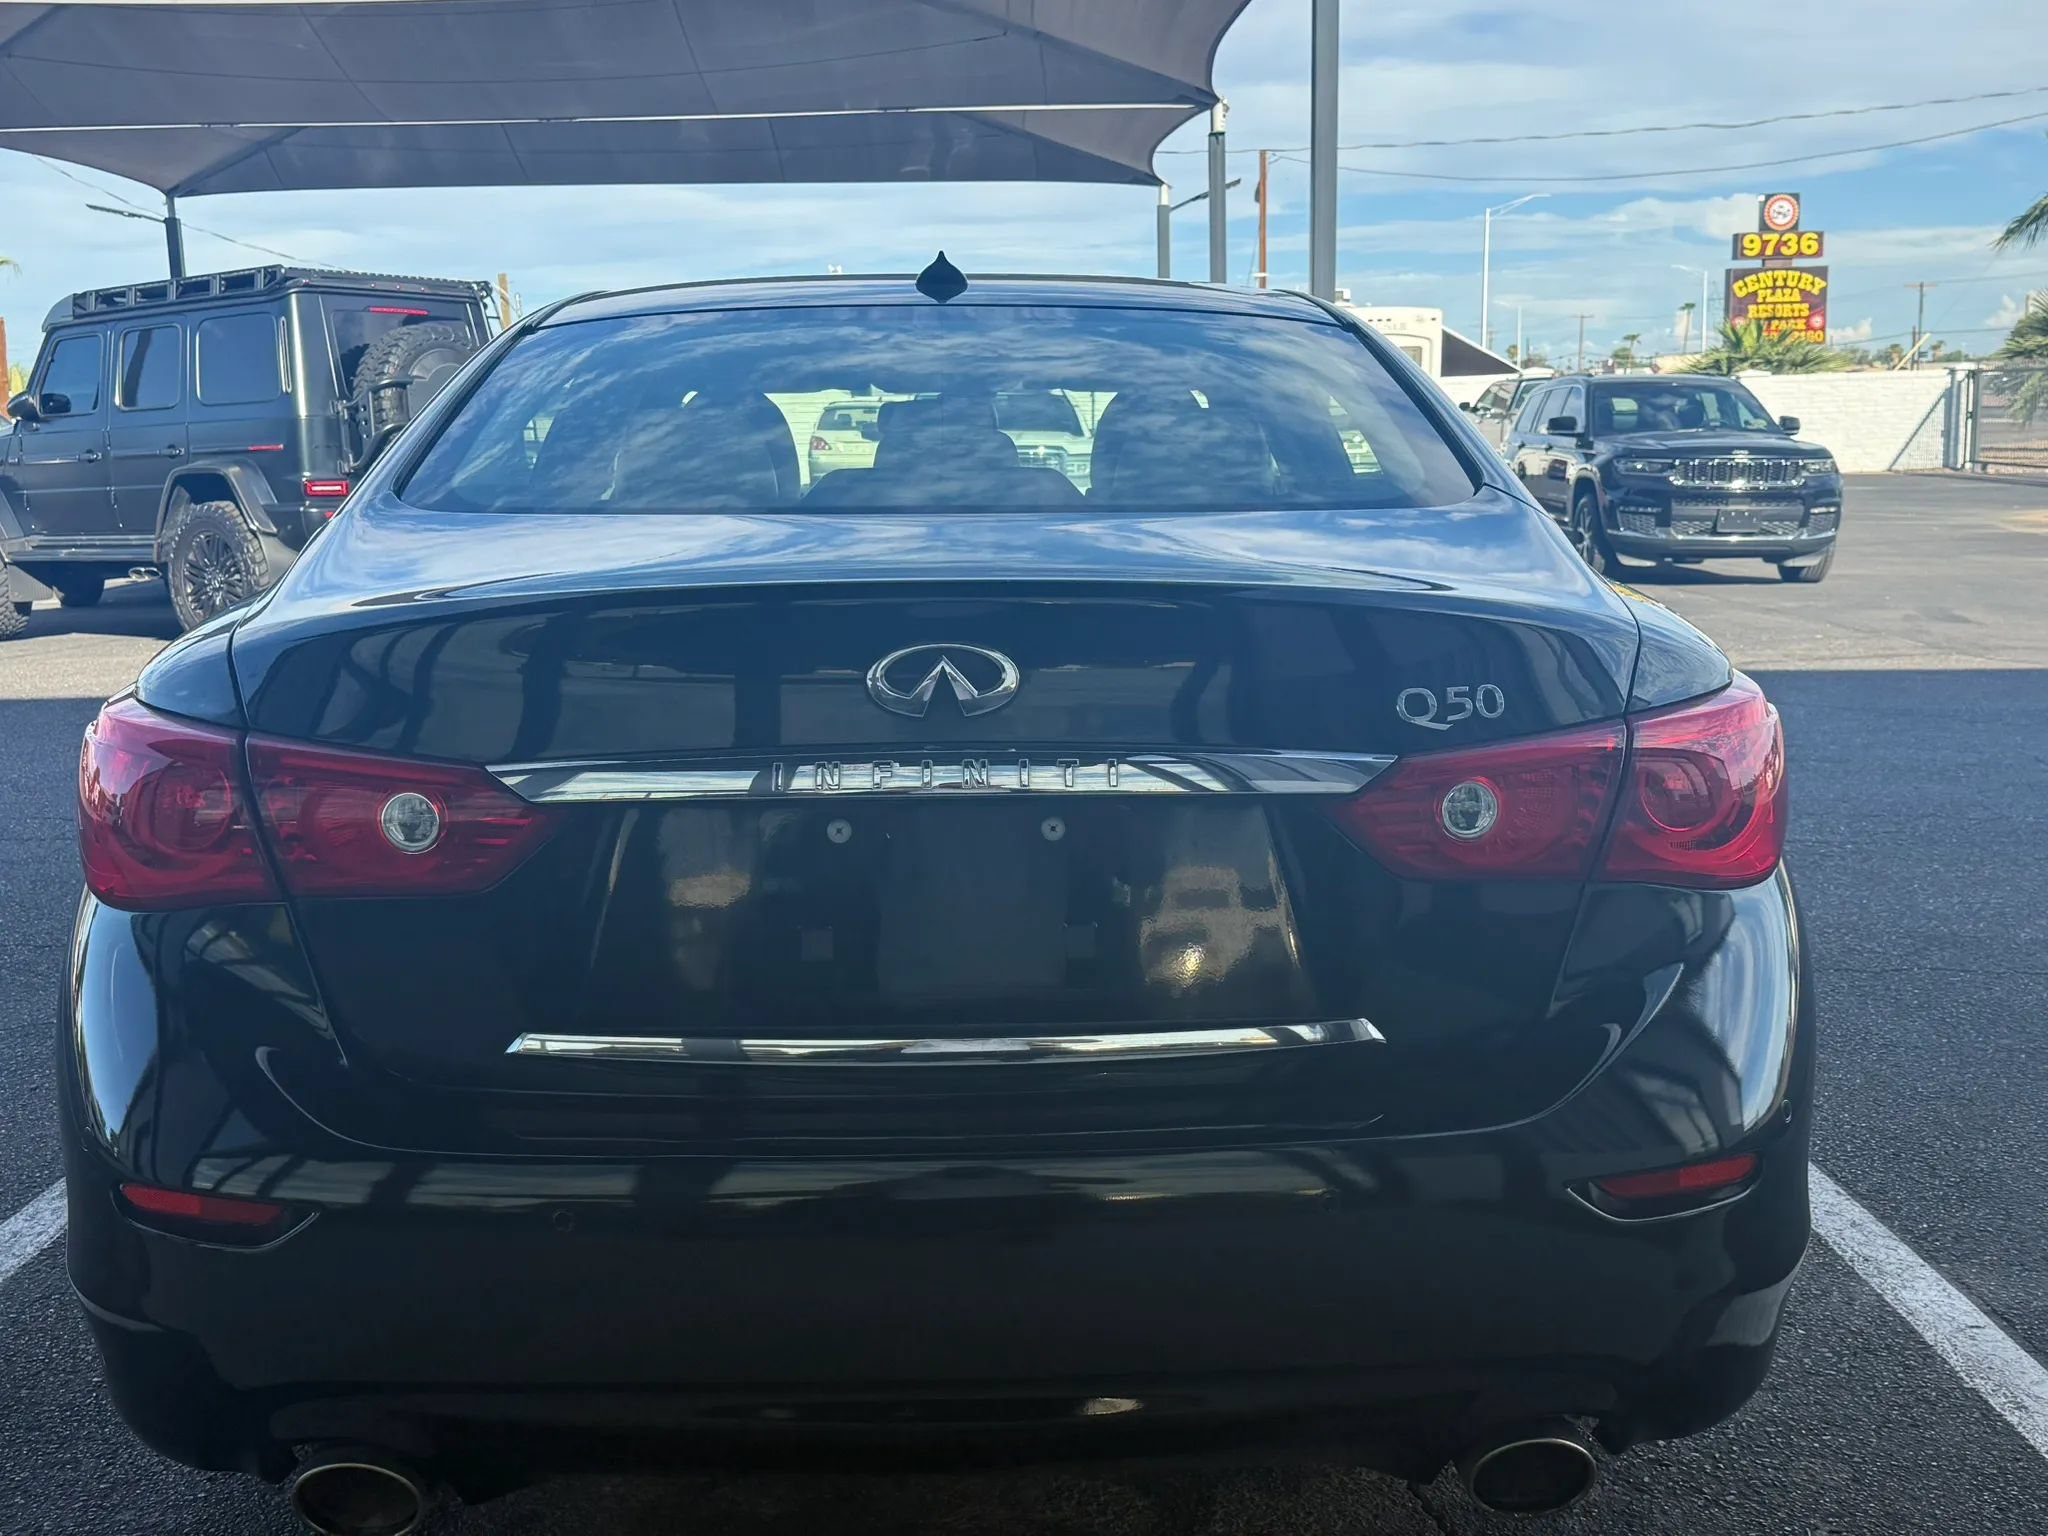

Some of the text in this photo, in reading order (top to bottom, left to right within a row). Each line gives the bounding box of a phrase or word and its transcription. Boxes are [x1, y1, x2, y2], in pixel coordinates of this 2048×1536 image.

[1743, 233, 1819, 256] 9736
[1733, 270, 1827, 297] CENTURY
[1757, 288, 1801, 302] PLAZA
[1748, 303, 1809, 318] RESORTS
[1397, 684, 1505, 731] Q50
[772, 758, 1120, 793] INFINITI
